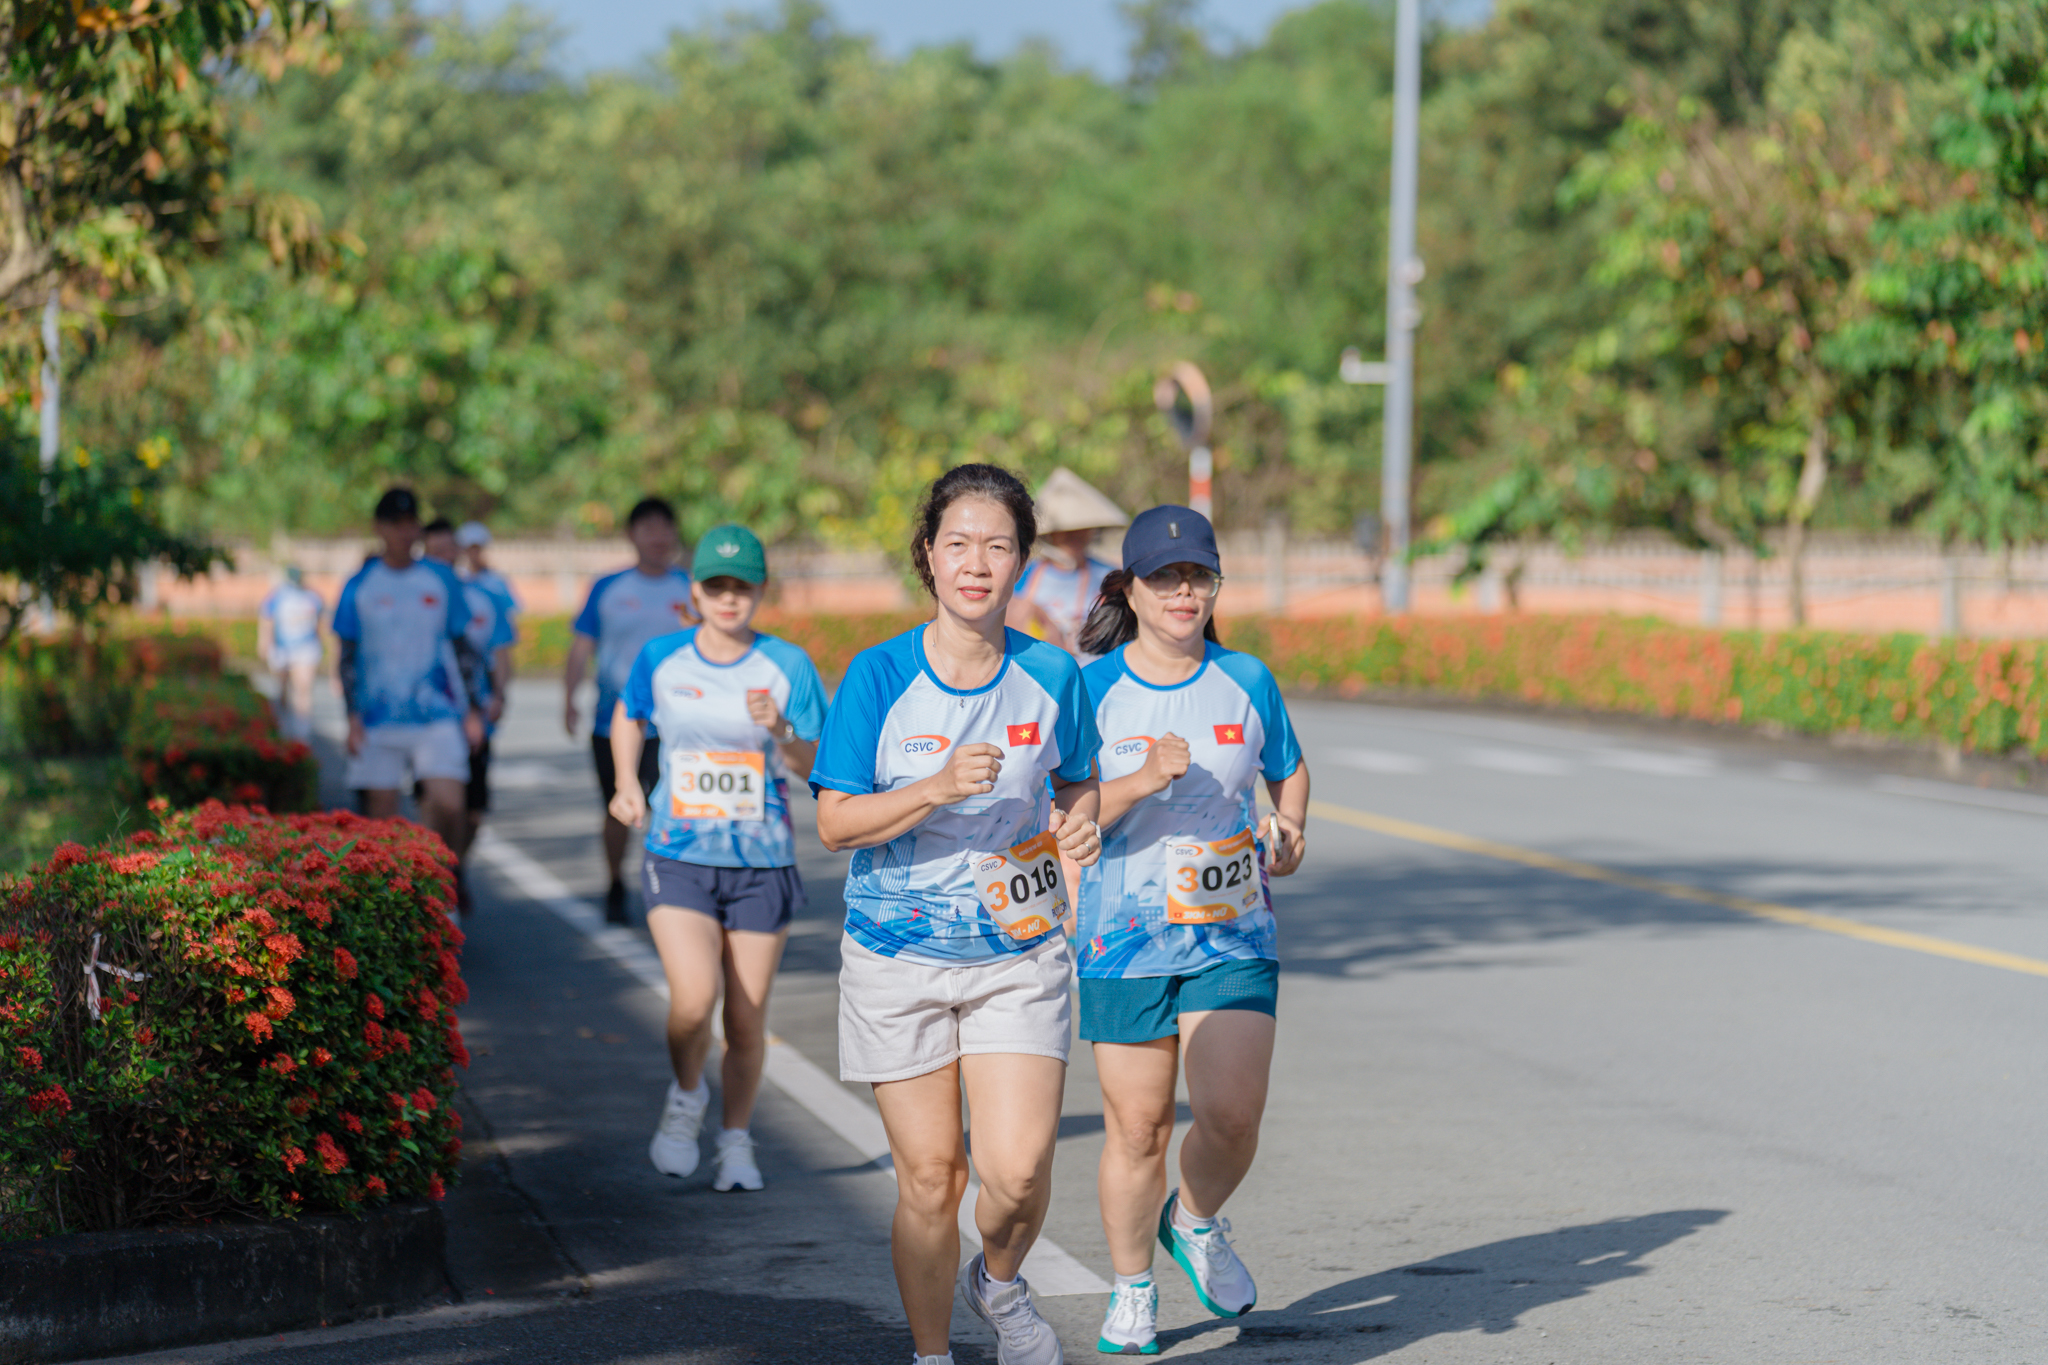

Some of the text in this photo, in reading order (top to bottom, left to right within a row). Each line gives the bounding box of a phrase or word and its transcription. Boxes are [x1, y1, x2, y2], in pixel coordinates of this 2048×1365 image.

[904, 741, 934, 753] CSVC
[1115, 742, 1142, 756] CSVC
[680, 771, 754, 794] 3001
[1175, 848, 1194, 856] CSVC
[980, 860, 998, 872] CSVC
[1176, 853, 1252, 893] 3023
[986, 859, 1058, 912] 3016
[1183, 911, 1205, 919] 3KM
